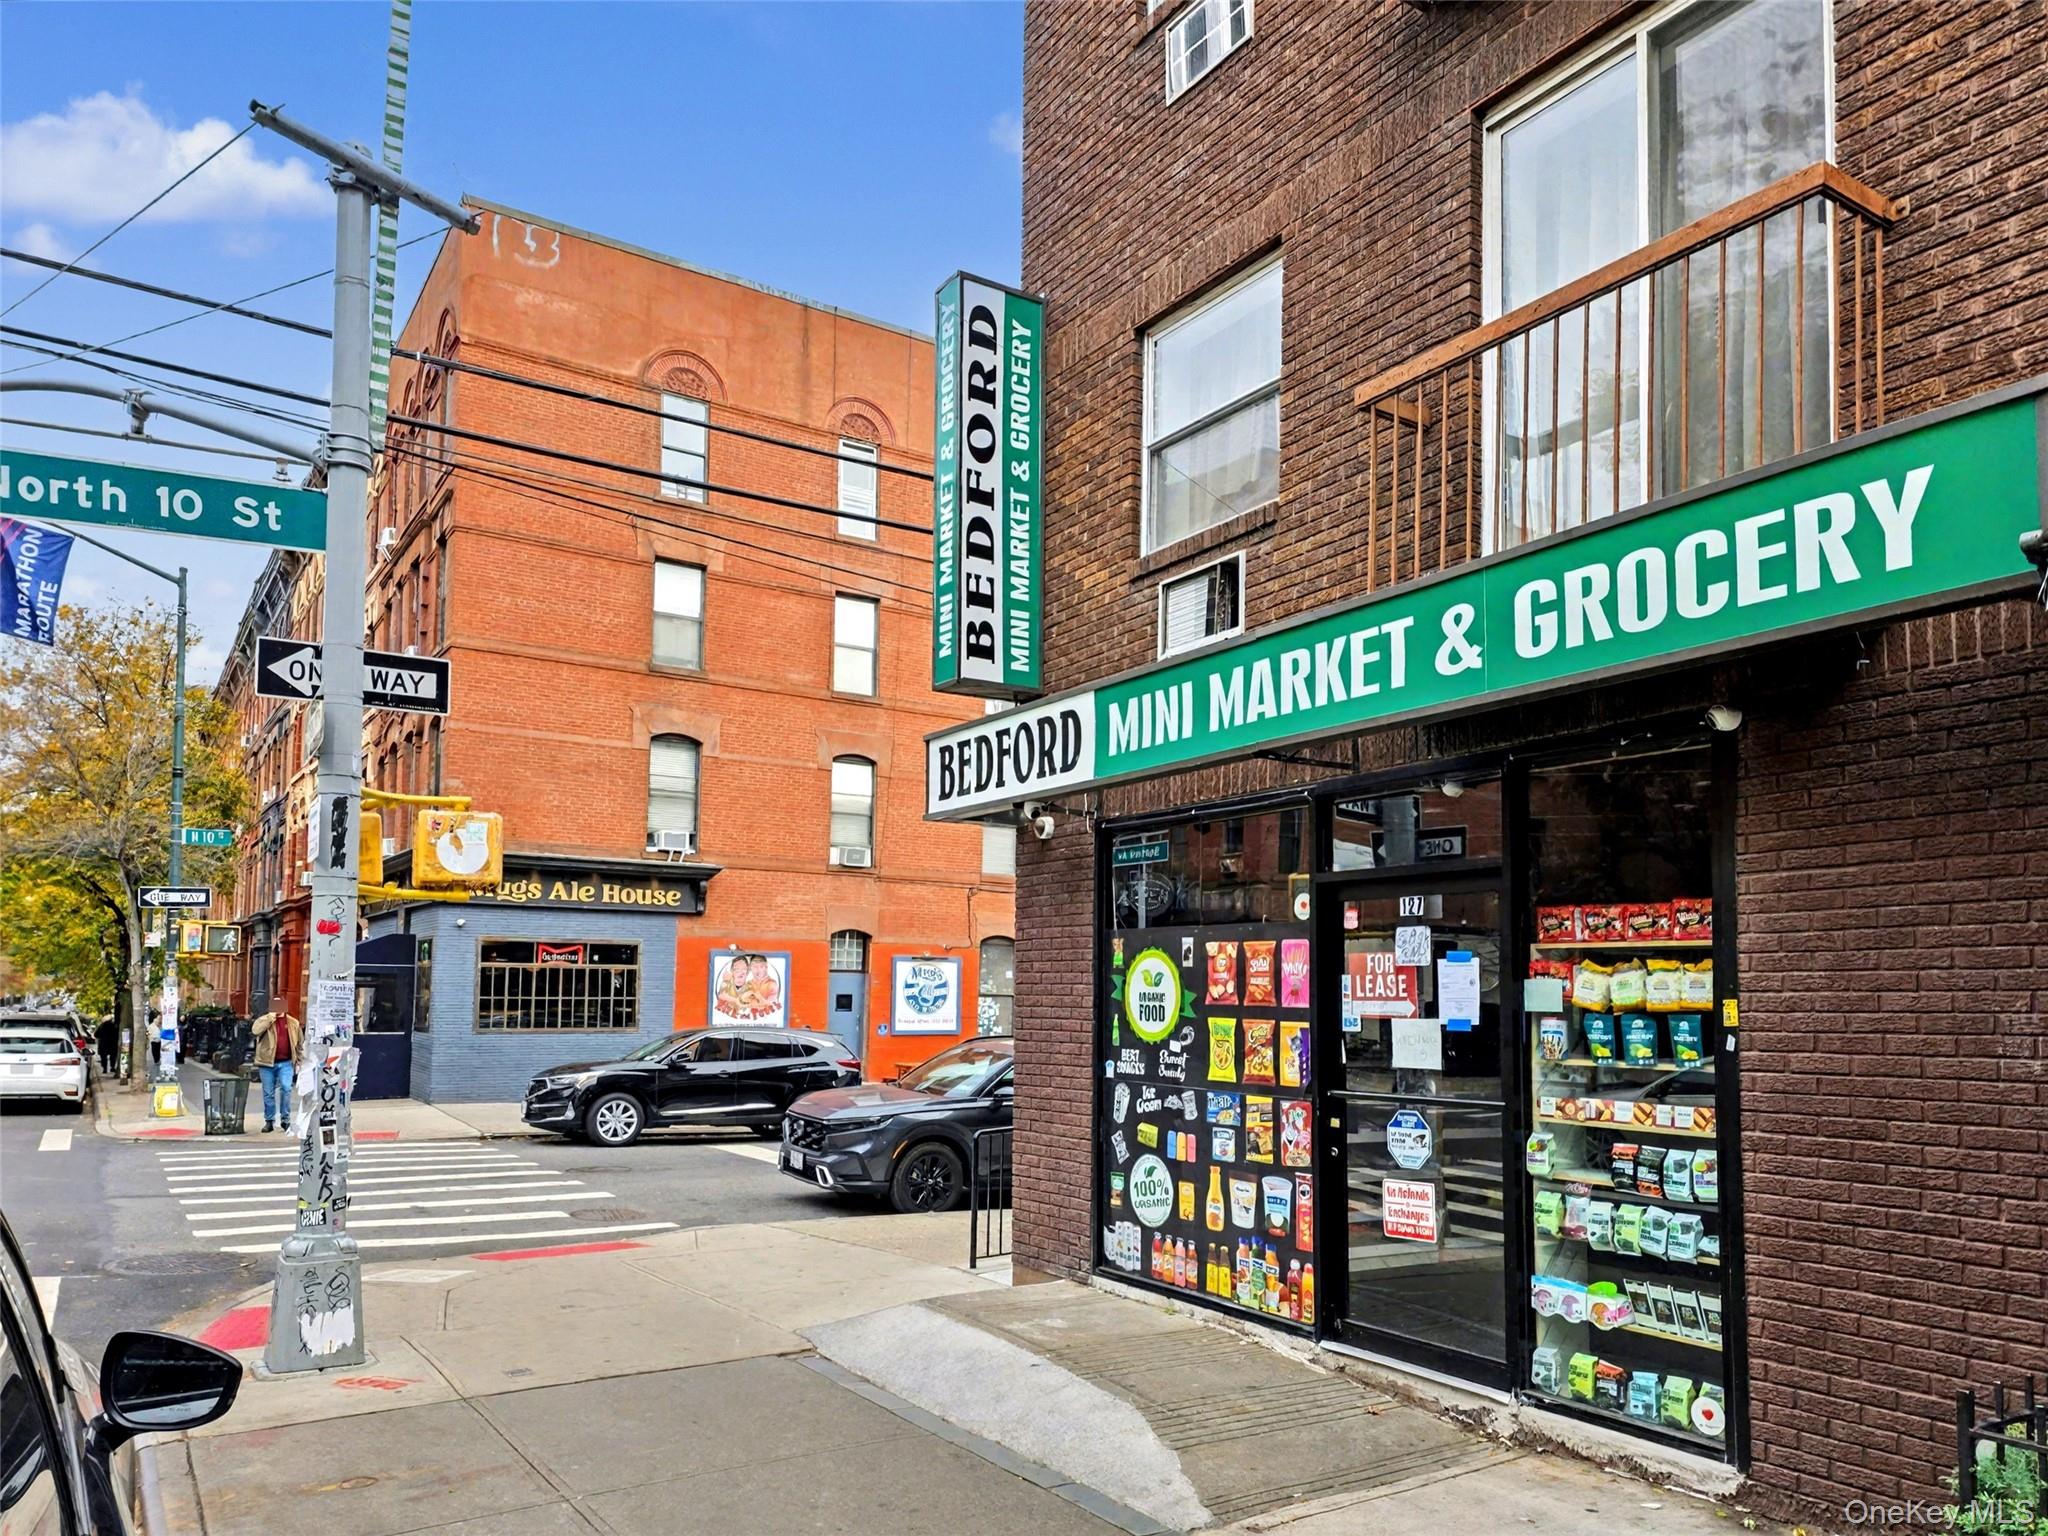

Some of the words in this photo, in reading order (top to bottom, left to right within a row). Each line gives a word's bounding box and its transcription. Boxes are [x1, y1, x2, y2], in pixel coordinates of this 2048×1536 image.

[940, 302, 956, 433] GROCERY
[1010, 319, 1032, 450] GROCERY
[940, 437, 954, 461] &
[966, 304, 998, 664] BEDFORD
[1010, 460, 1031, 482] &
[156, 486, 203, 521] 10
[232, 496, 282, 531] St
[939, 473, 954, 586] MARKET
[1010, 486, 1030, 601] MARKET
[14, 528, 44, 637] MARATHON
[36, 580, 58, 642] ROUTE
[938, 709, 1083, 802] BEDFORD
[1108, 680, 1193, 757] MINI
[1208, 615, 1415, 733] MARKET
[1433, 602, 1484, 677] &
[1513, 464, 1935, 659] GROCERY
[939, 593, 953, 658] MINI
[1010, 609, 1030, 672] MINI
[289, 660, 322, 682] ON
[371, 668, 425, 695] WAY
[191, 831, 199, 843] N
[202, 831, 215, 844] 10
[547, 881, 595, 902] Ale
[602, 884, 682, 907] House
[1402, 896, 1423, 915] 127
[1366, 953, 1394, 974] FOR
[1138, 991, 1166, 1003] ORGANIC
[1356, 975, 1408, 998] LEASE
[1139, 1004, 1166, 1022] FOOD
[1116, 1060, 1145, 1075] SNACKS
[1121, 1048, 1140, 1062] BEST
[1134, 1179, 1170, 1197] 100%
[1134, 1197, 1171, 1209] ORGANIC
